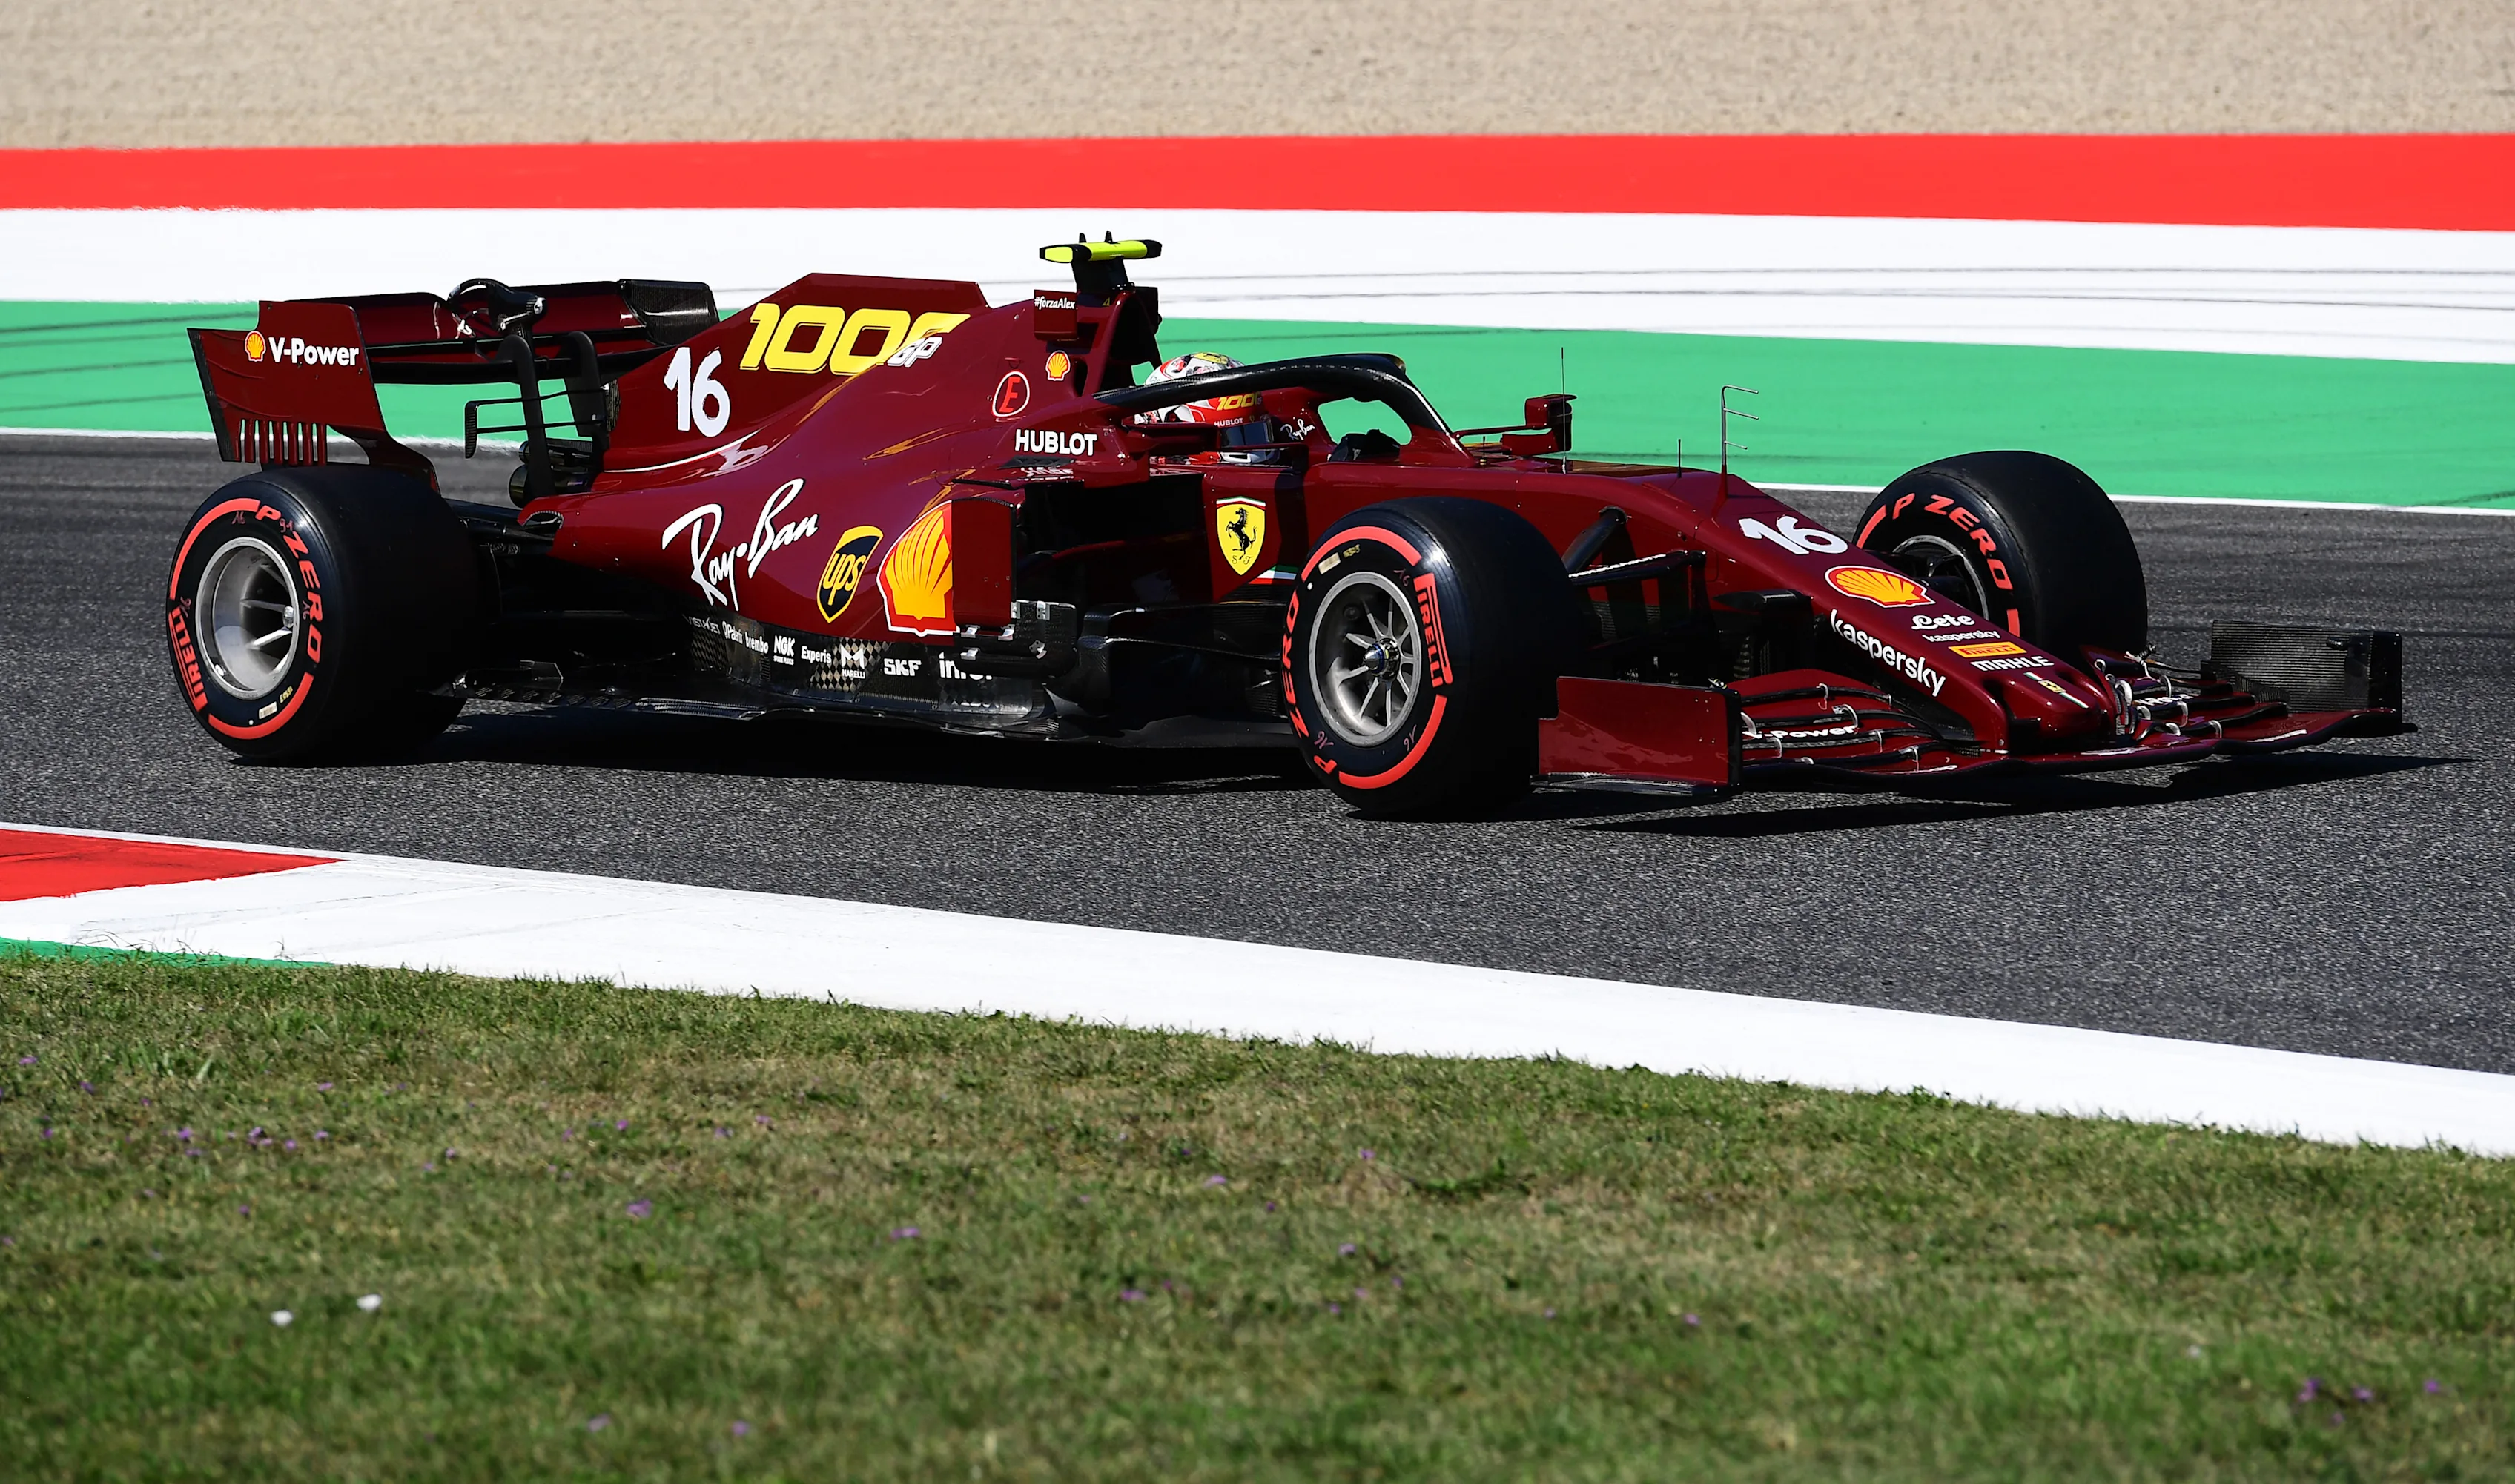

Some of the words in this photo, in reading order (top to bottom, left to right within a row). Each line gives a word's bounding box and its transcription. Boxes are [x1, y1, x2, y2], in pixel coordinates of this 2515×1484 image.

[1034, 296, 1076, 311] #forzaAlex
[268, 337, 360, 366] V-Power
[663, 346, 731, 437] 16
[998, 377, 1021, 413] E
[1214, 417, 1244, 428] HUBLOT
[1014, 428, 1098, 457] HUBLOT
[1739, 515, 1848, 555] 16
[1893, 492, 1915, 520] P
[1924, 494, 2014, 590] ZERO
[255, 505, 282, 520] P
[282, 531, 323, 663] ZERO
[822, 553, 867, 606] ups
[1413, 572, 1453, 688] PIRELLI
[1911, 614, 1975, 630] Lete
[744, 632, 769, 654] brembo
[773, 635, 796, 657] NGK
[1922, 630, 2001, 643] kaspersky
[168, 606, 208, 712] PIRELLI
[801, 646, 833, 664] Experis
[1830, 608, 1946, 697] kaspersky
[1960, 644, 2017, 655] PIRELLI
[842, 669, 866, 680] MARELLI
[883, 657, 922, 677] SKF
[1282, 590, 1309, 739] ZERO
[1970, 655, 2055, 672] MAHLE
[1741, 725, 1857, 739] V-Power
